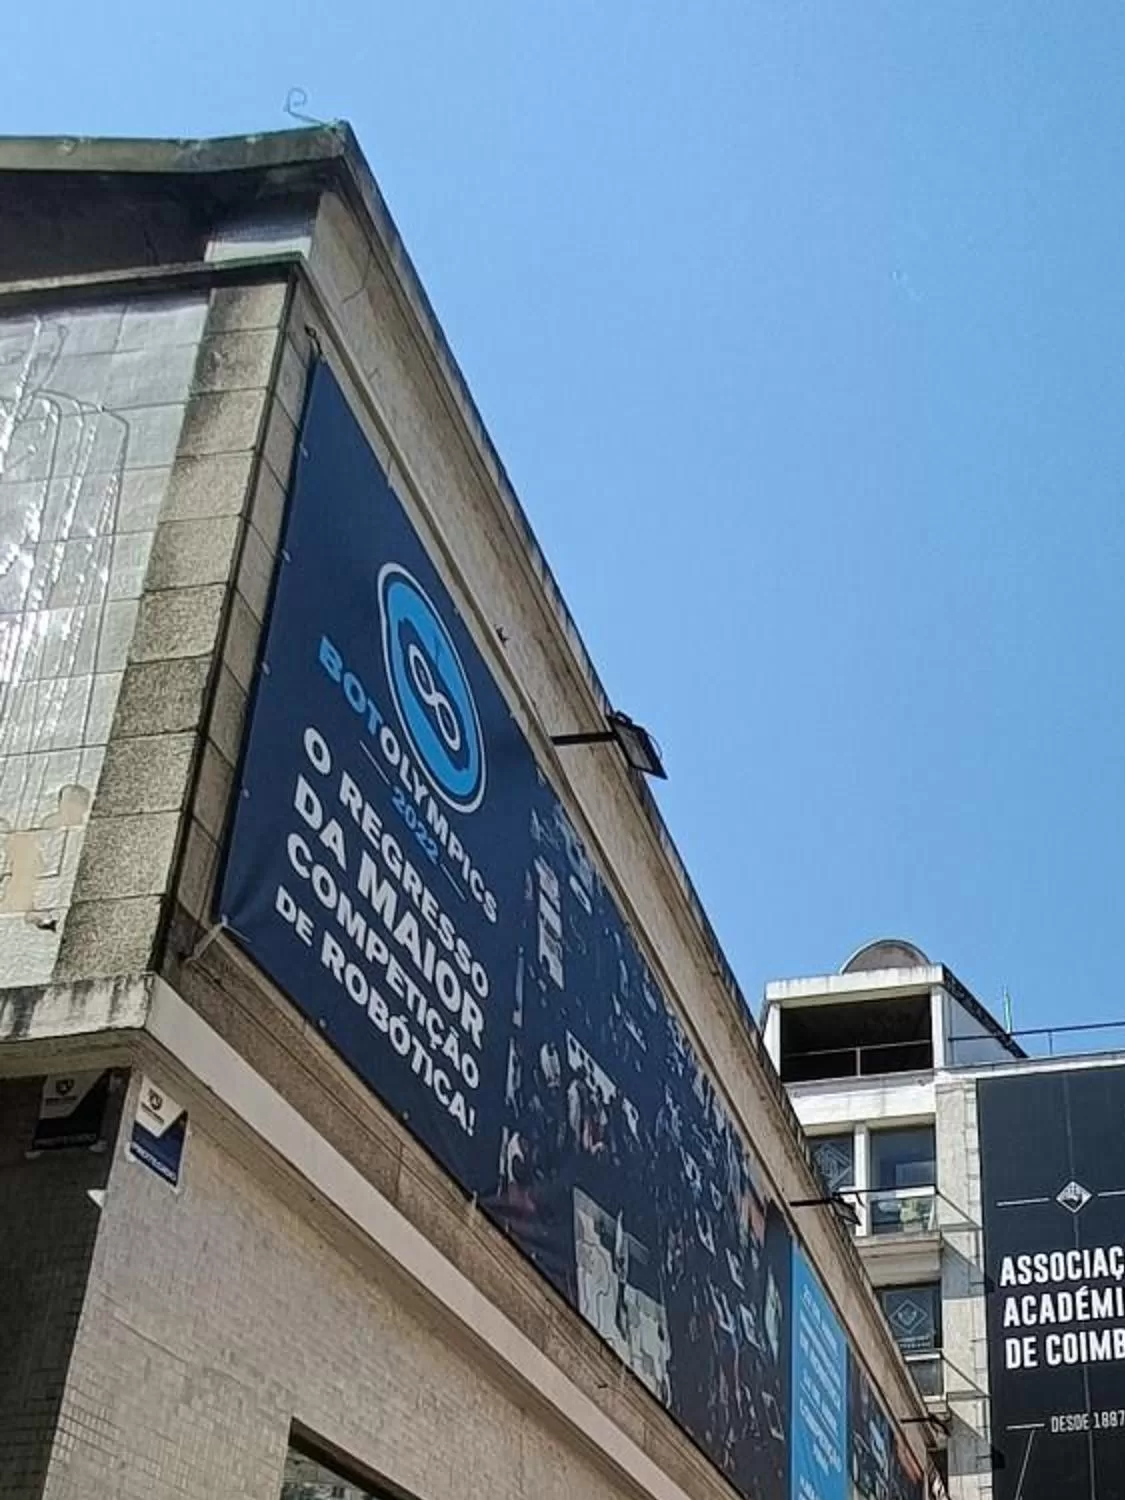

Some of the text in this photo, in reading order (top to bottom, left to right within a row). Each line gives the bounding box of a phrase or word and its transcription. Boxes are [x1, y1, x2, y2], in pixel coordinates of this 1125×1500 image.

[303, 727, 489, 998] O REGRESSO
[318, 636, 498, 923] BOTOLYMPICS
[391, 791, 440, 865] 2022
[275, 885, 476, 1137] DE ROBÓTICA!
[287, 833, 479, 1090] COMPETIÇÃO
[294, 774, 485, 1050] DA MAIOR
[1006, 1336, 1037, 1369] DE
[1051, 1410, 1125, 1434] DESDE 1887
